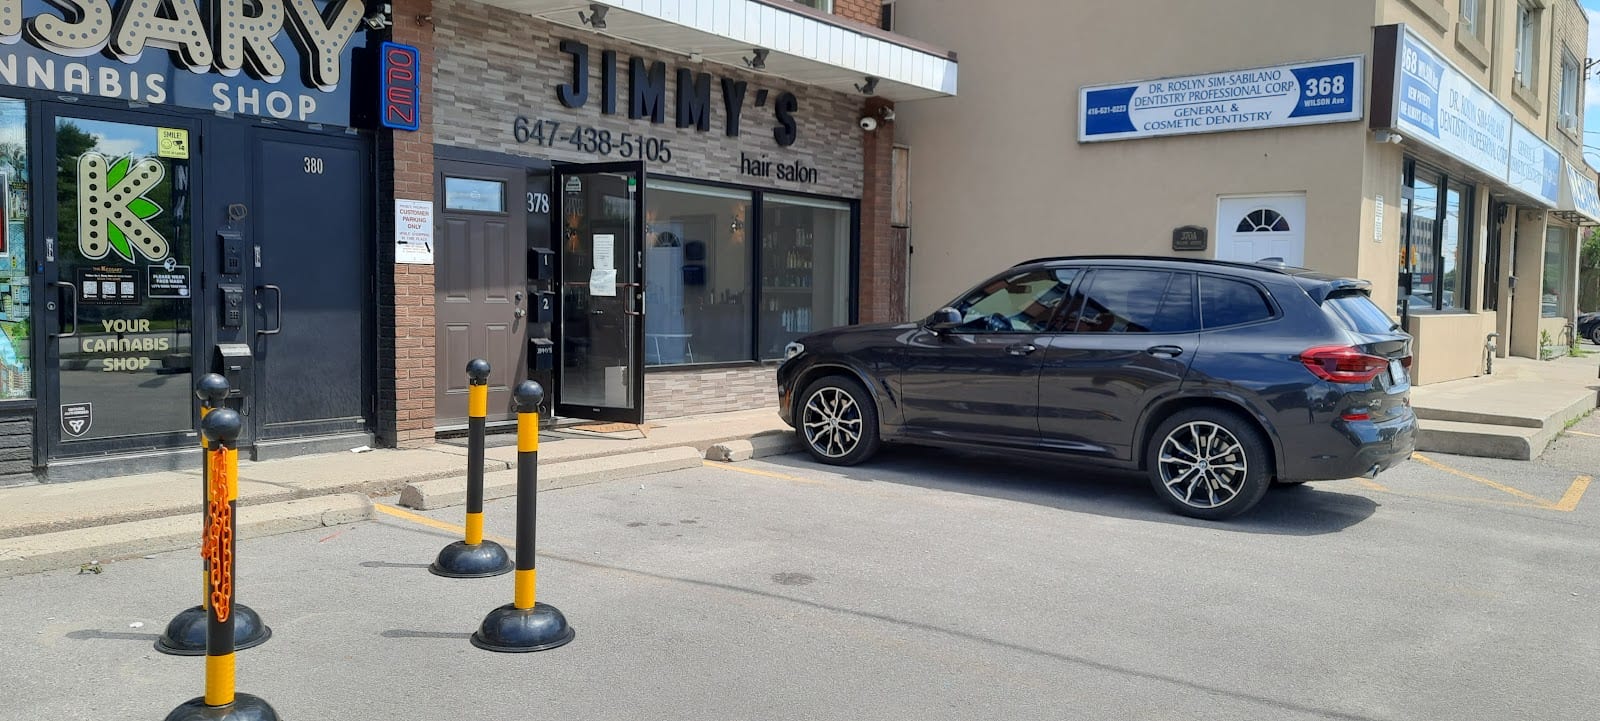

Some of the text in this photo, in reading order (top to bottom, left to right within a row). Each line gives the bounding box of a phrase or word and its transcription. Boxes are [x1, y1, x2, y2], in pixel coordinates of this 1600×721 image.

[387, 50, 413, 123] OPEN
[1148, 70, 1281, 94] DR. ROSLYN SIM-SABILANO
[1305, 75, 1345, 97] 368
[212, 83, 317, 121] SHOP
[556, 39, 799, 147] JIMMY'S
[1134, 80, 1297, 107] DENTISTRY PROFESSIONAL CORP.
[1304, 98, 1330, 107] WILSON
[1174, 103, 1240, 117] GENERAL &
[1143, 111, 1272, 131] COSMETIC DENTISTRY
[513, 115, 672, 164] 647-438-5105
[304, 156, 324, 175] 380
[740, 152, 818, 184] hair salon
[527, 192, 550, 213] 378
[544, 253, 549, 266] 1
[543, 298, 550, 310] 2
[102, 318, 150, 333] YOUR
[82, 337, 169, 353] CANNABIS
[103, 357, 151, 372] SHOP
